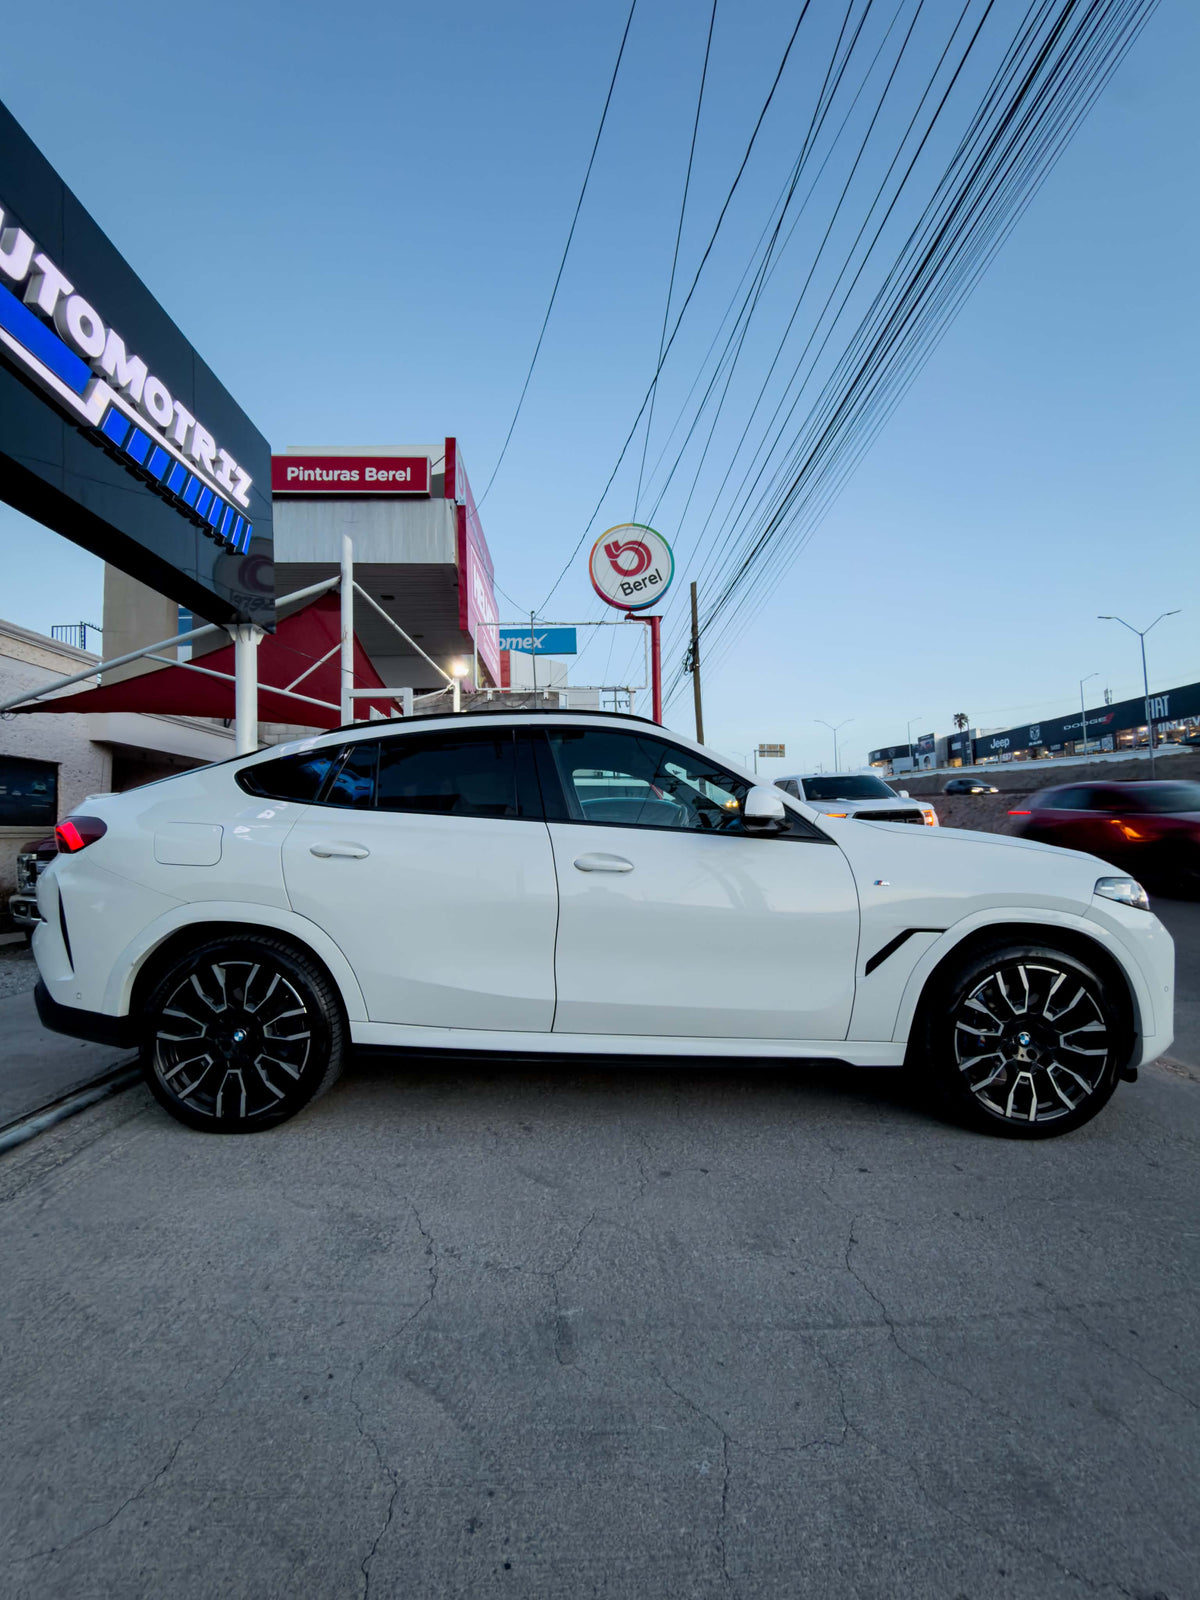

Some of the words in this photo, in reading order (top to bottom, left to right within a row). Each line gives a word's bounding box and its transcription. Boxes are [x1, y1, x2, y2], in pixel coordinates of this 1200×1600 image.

[287, 466, 360, 481] Pinturas
[365, 467, 411, 481] Berel
[620, 568, 663, 596] Berel
[990, 738, 1010, 749] Jeep
